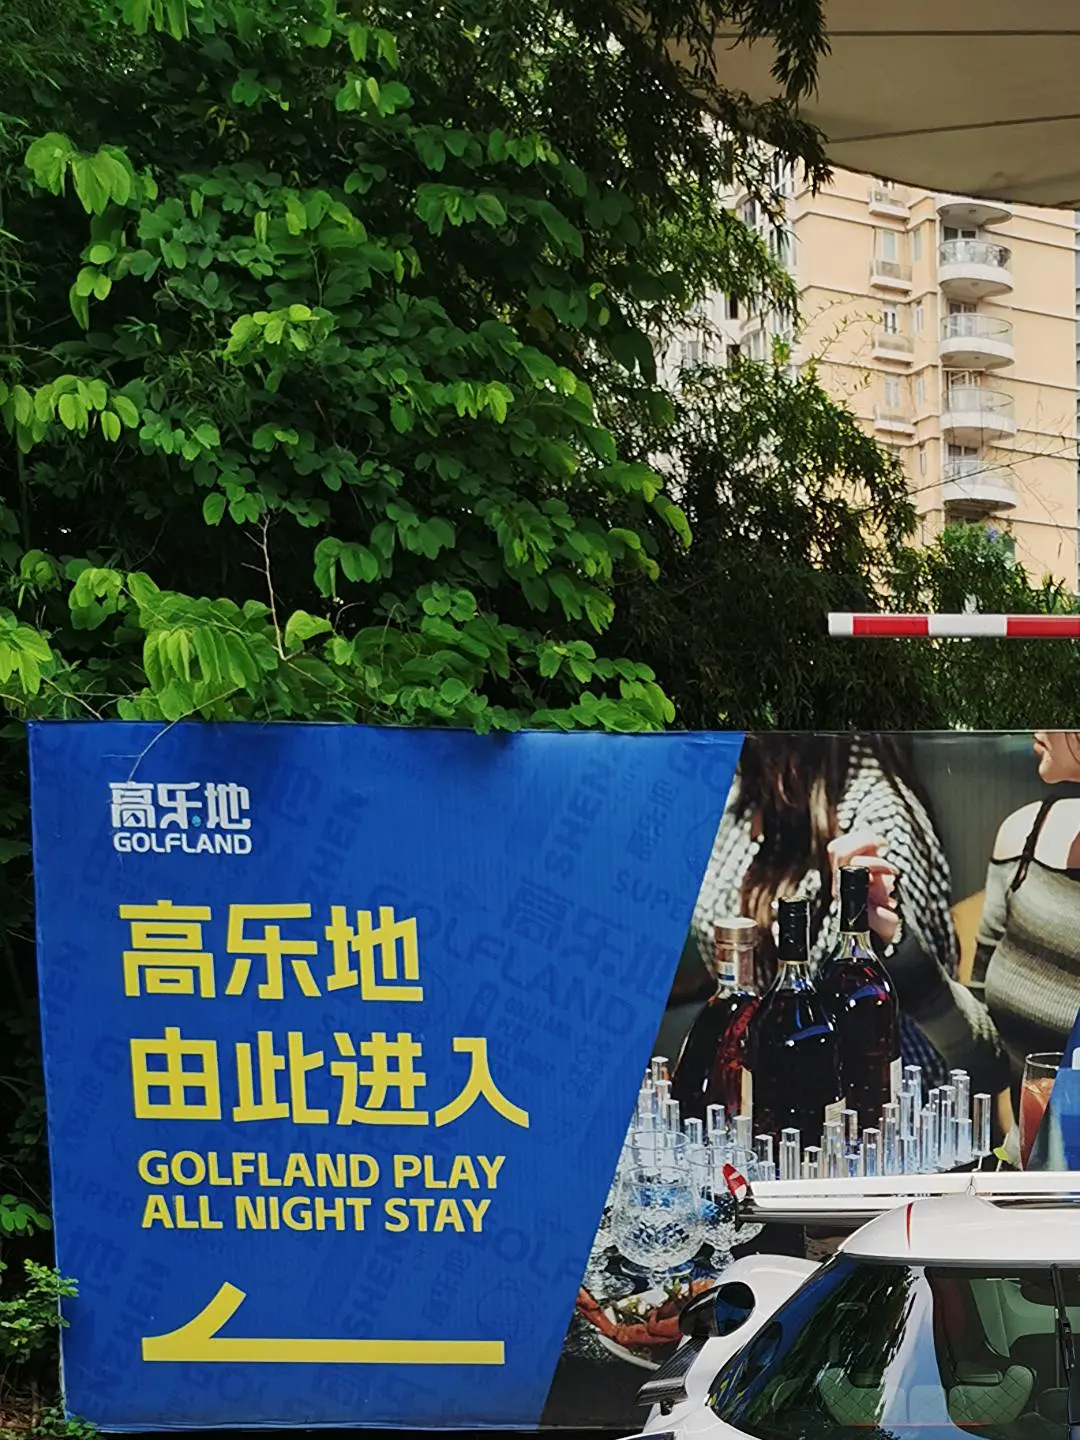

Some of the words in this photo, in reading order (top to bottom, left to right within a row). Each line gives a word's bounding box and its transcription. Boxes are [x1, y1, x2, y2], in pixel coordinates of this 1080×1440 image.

[109, 781, 252, 830] 高乐地
[113, 832, 252, 855] GOLFLAND
[119, 900, 423, 1002] 高乐地
[130, 1026, 529, 1128] 由此进入
[137, 1150, 381, 1188] GOLFLAND
[392, 1153, 507, 1190] PLAY
[141, 1193, 224, 1230] ALL
[234, 1194, 373, 1232] NIGHT
[384, 1196, 492, 1233] STAY
